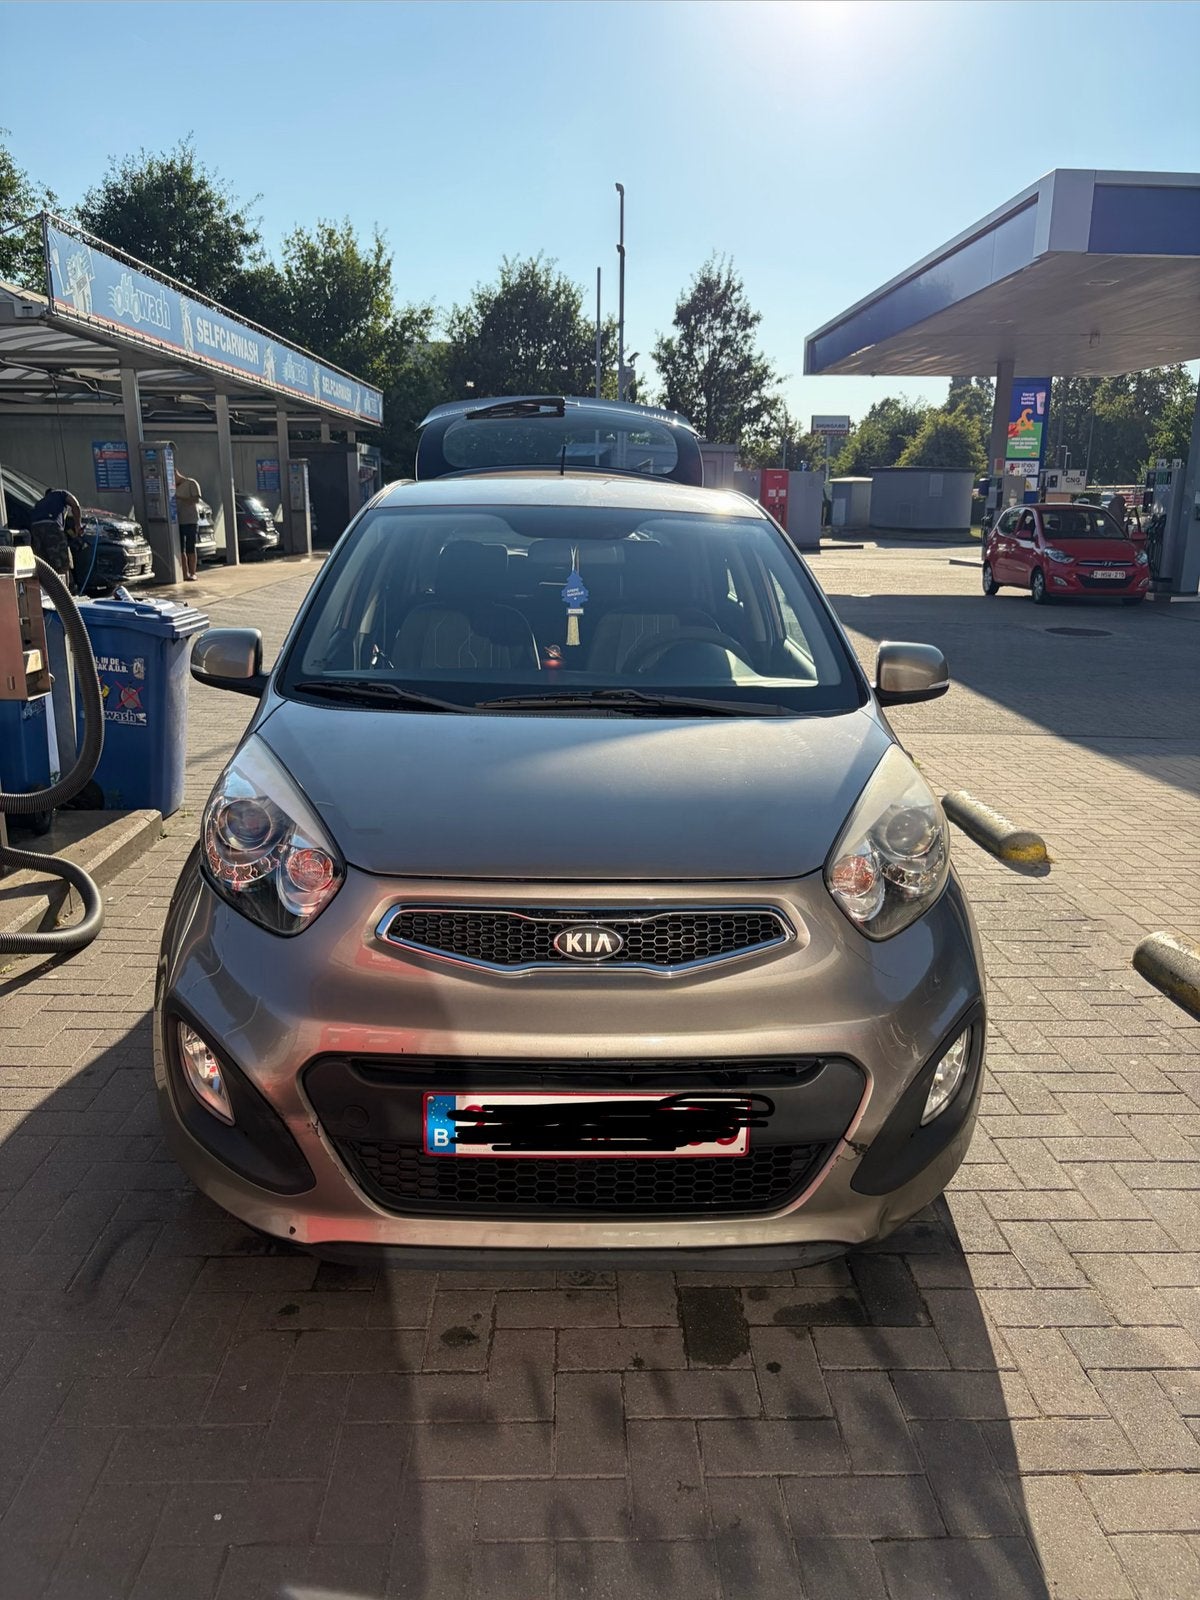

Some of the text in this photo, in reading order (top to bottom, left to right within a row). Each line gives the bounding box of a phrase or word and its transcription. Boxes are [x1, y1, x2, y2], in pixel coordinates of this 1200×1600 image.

[197, 317, 259, 365] SELFCARWASH
[566, 933, 613, 953] KIA
[433, 1128, 449, 1147] B
